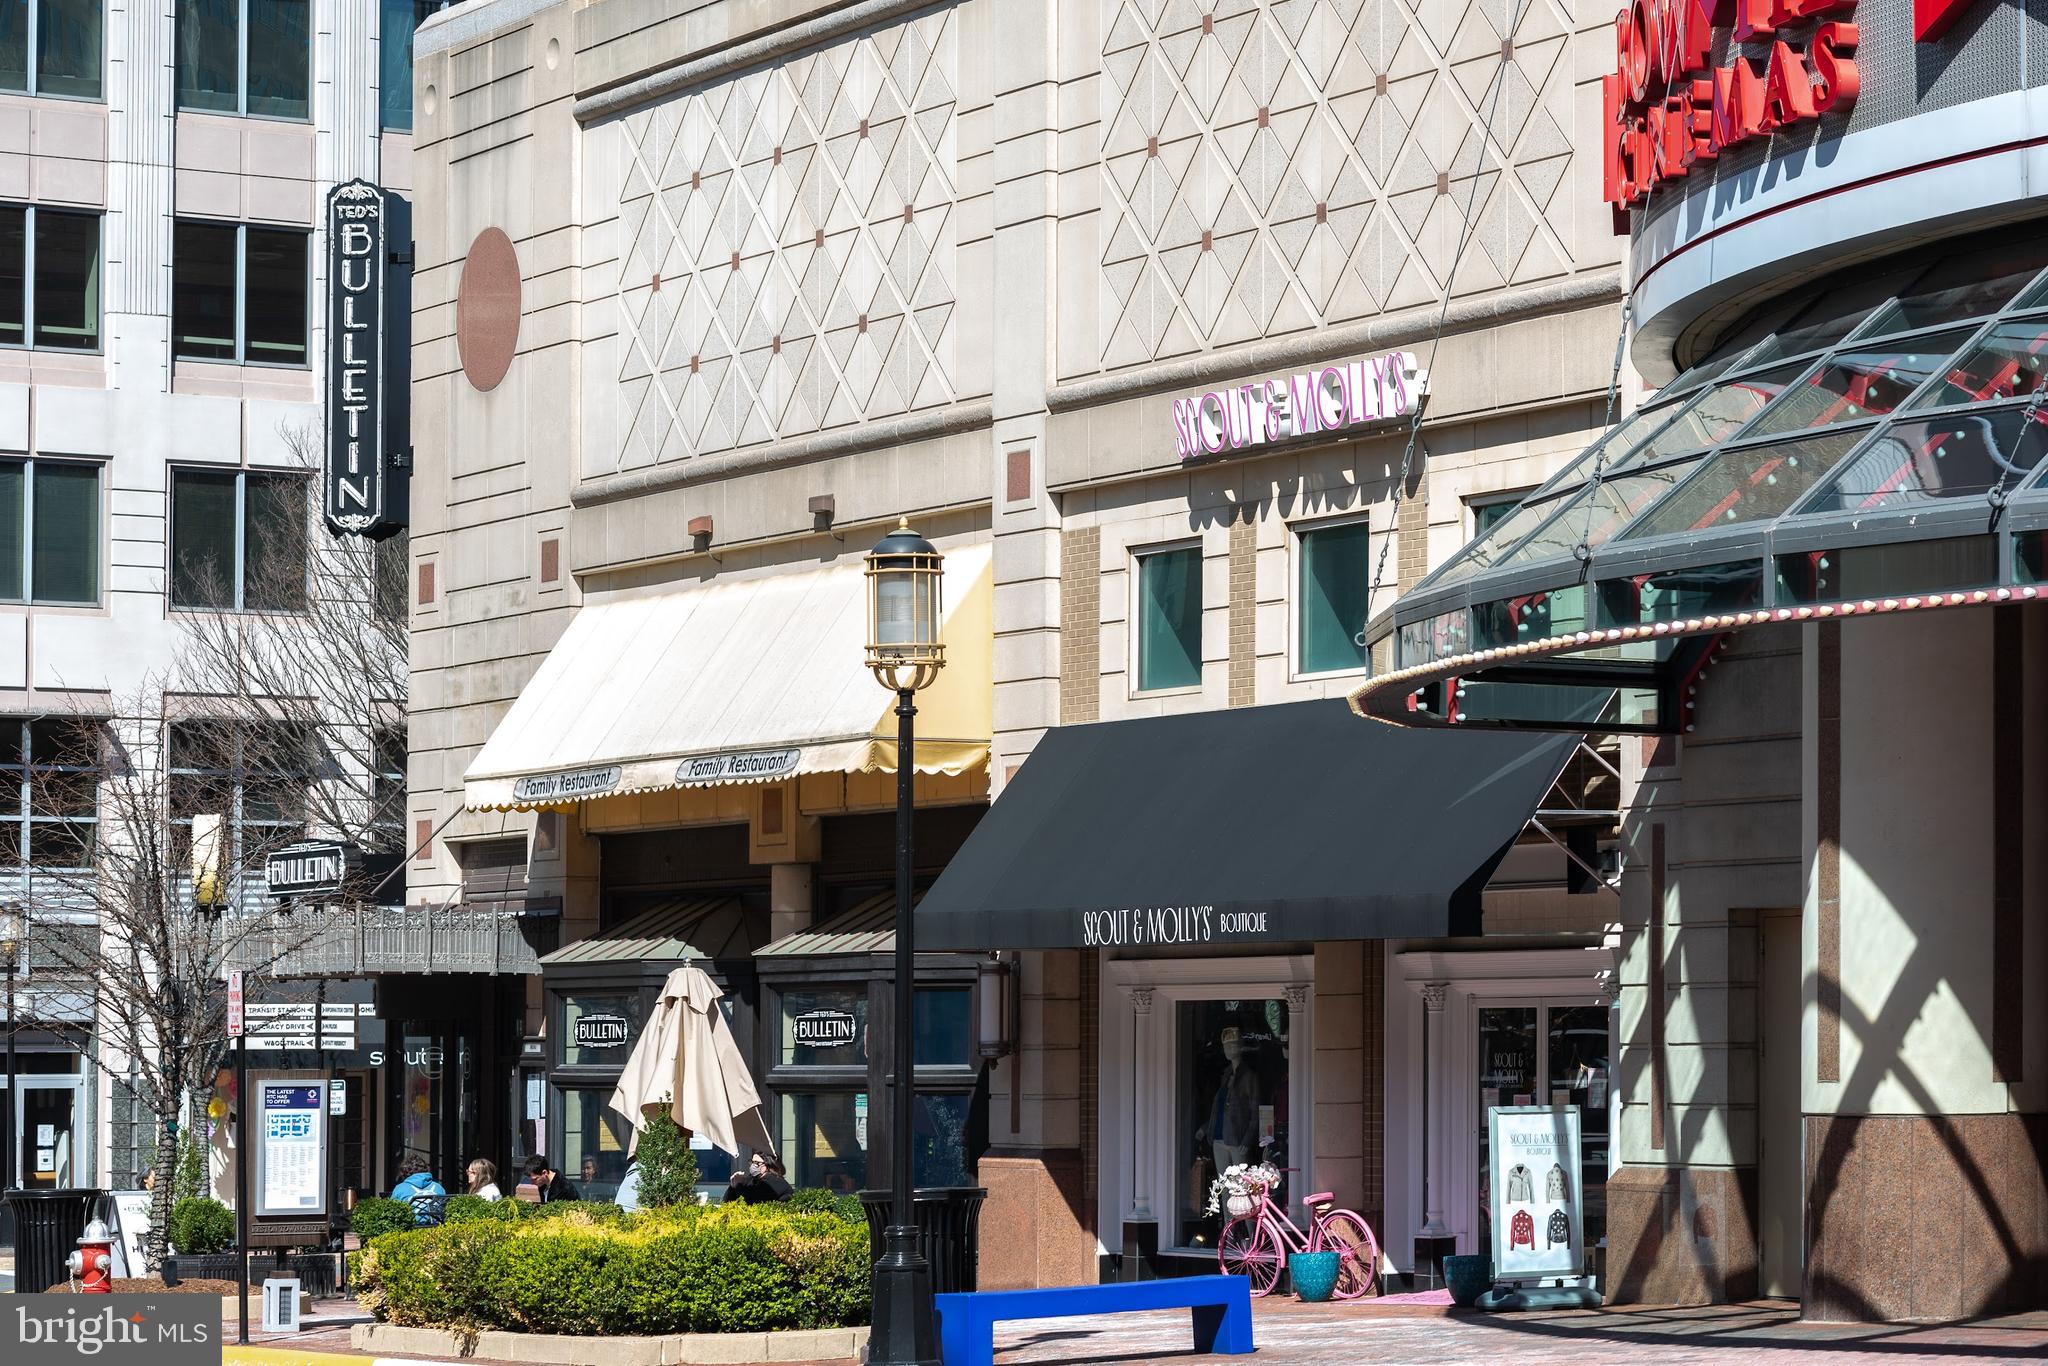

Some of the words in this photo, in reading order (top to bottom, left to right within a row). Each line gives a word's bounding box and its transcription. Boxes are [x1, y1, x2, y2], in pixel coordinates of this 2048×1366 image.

[1618, 22, 1860, 211] CINEMAS
[336, 205, 379, 220] TED'S
[339, 223, 373, 509] BULLETIN
[1173, 384, 1255, 459] SCOUT
[1264, 379, 1283, 442] &
[1290, 352, 1409, 434] MOLLY'S
[688, 756, 726, 778] Family
[729, 752, 789, 773] Restaurant
[524, 777, 554, 797] Family
[559, 769, 611, 790] Restaurant
[271, 856, 338, 886] BULLETIN
[1083, 910, 1129, 945] SCOUT
[1133, 909, 1142, 943] &
[1147, 906, 1212, 943] MOLLY'S
[1220, 912, 1267, 933] BOUTIQUE
[579, 1023, 623, 1039] BULLETIN
[799, 1021, 850, 1038] BULLETIN
[1494, 1053, 1517, 1068] SCOUT
[1518, 1053, 1524, 1067] &
[1494, 1069, 1525, 1084] MOLLY'S
[1510, 1133, 1532, 1144] SCOUT
[1534, 1133, 1539, 1144] &
